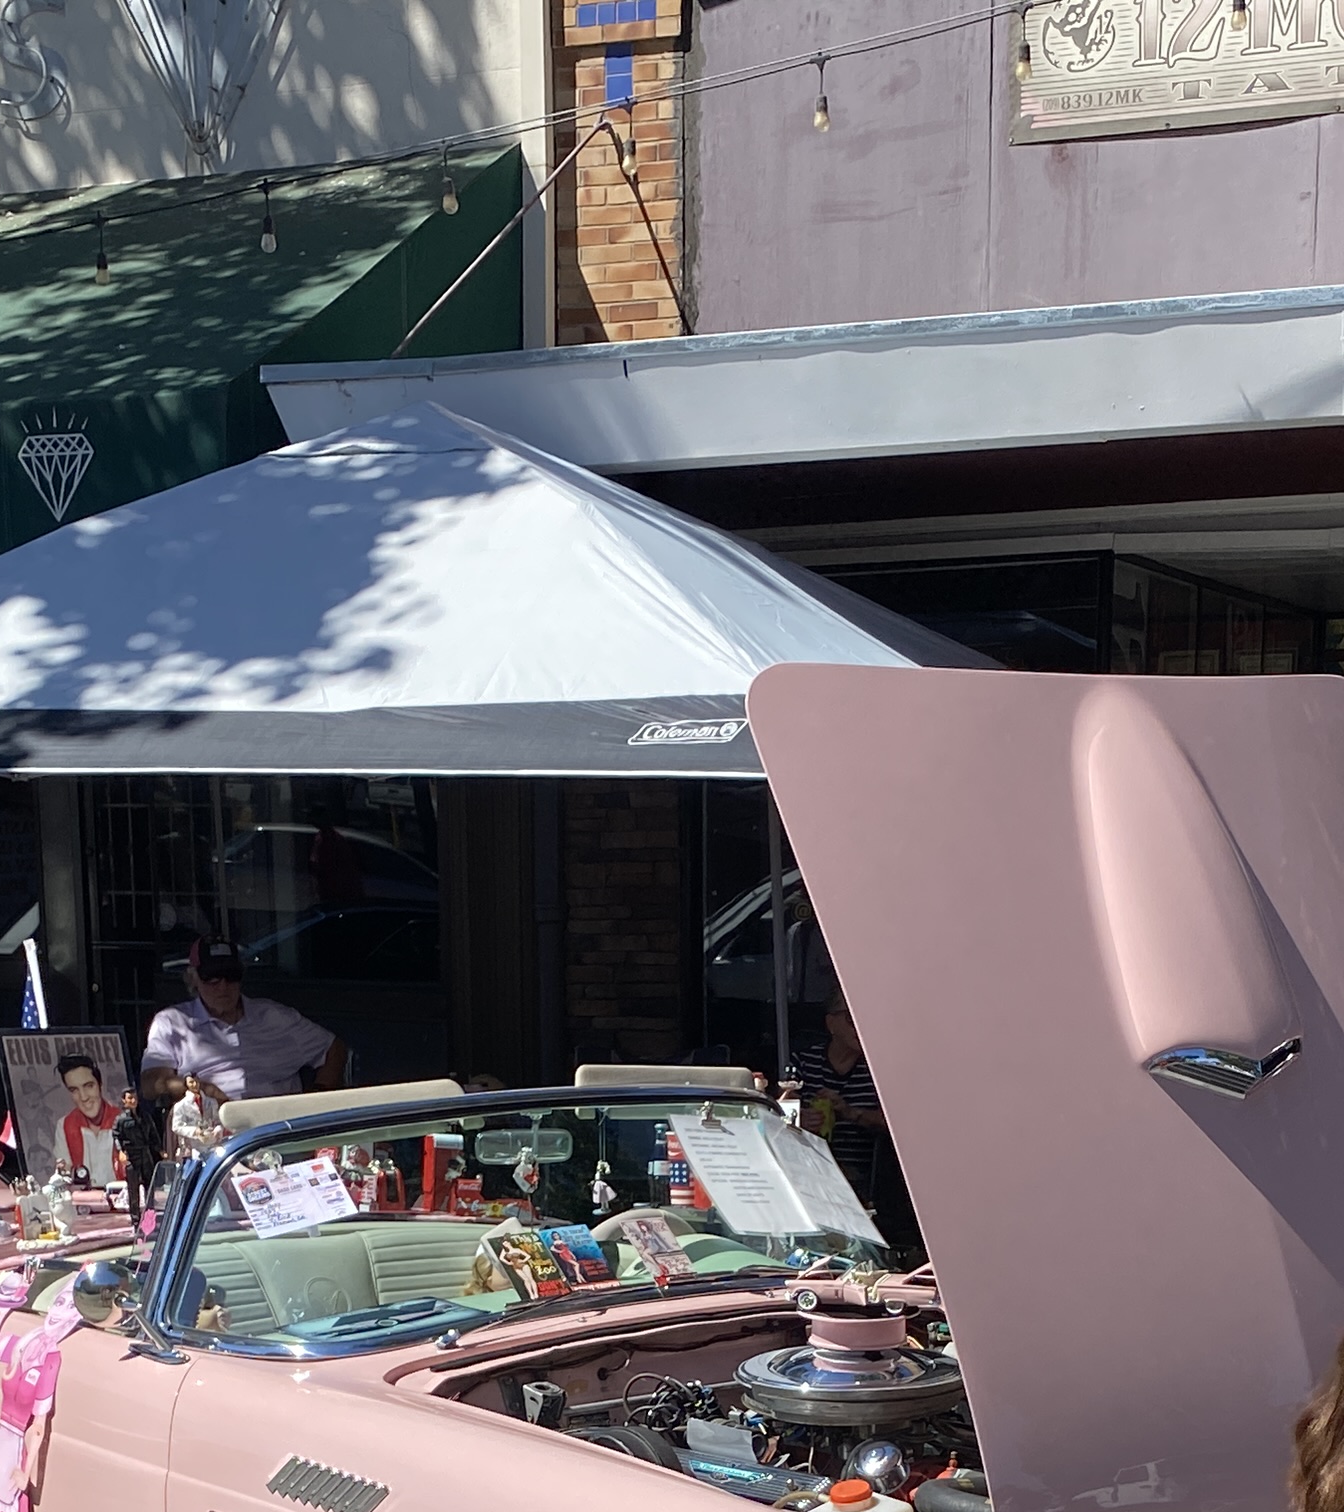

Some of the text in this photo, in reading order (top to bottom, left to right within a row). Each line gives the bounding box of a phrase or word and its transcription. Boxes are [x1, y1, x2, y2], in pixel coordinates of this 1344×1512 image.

[642, 724, 719, 740] Coleman
[5, 1036, 121, 1065] ELVIS PRESLEY
